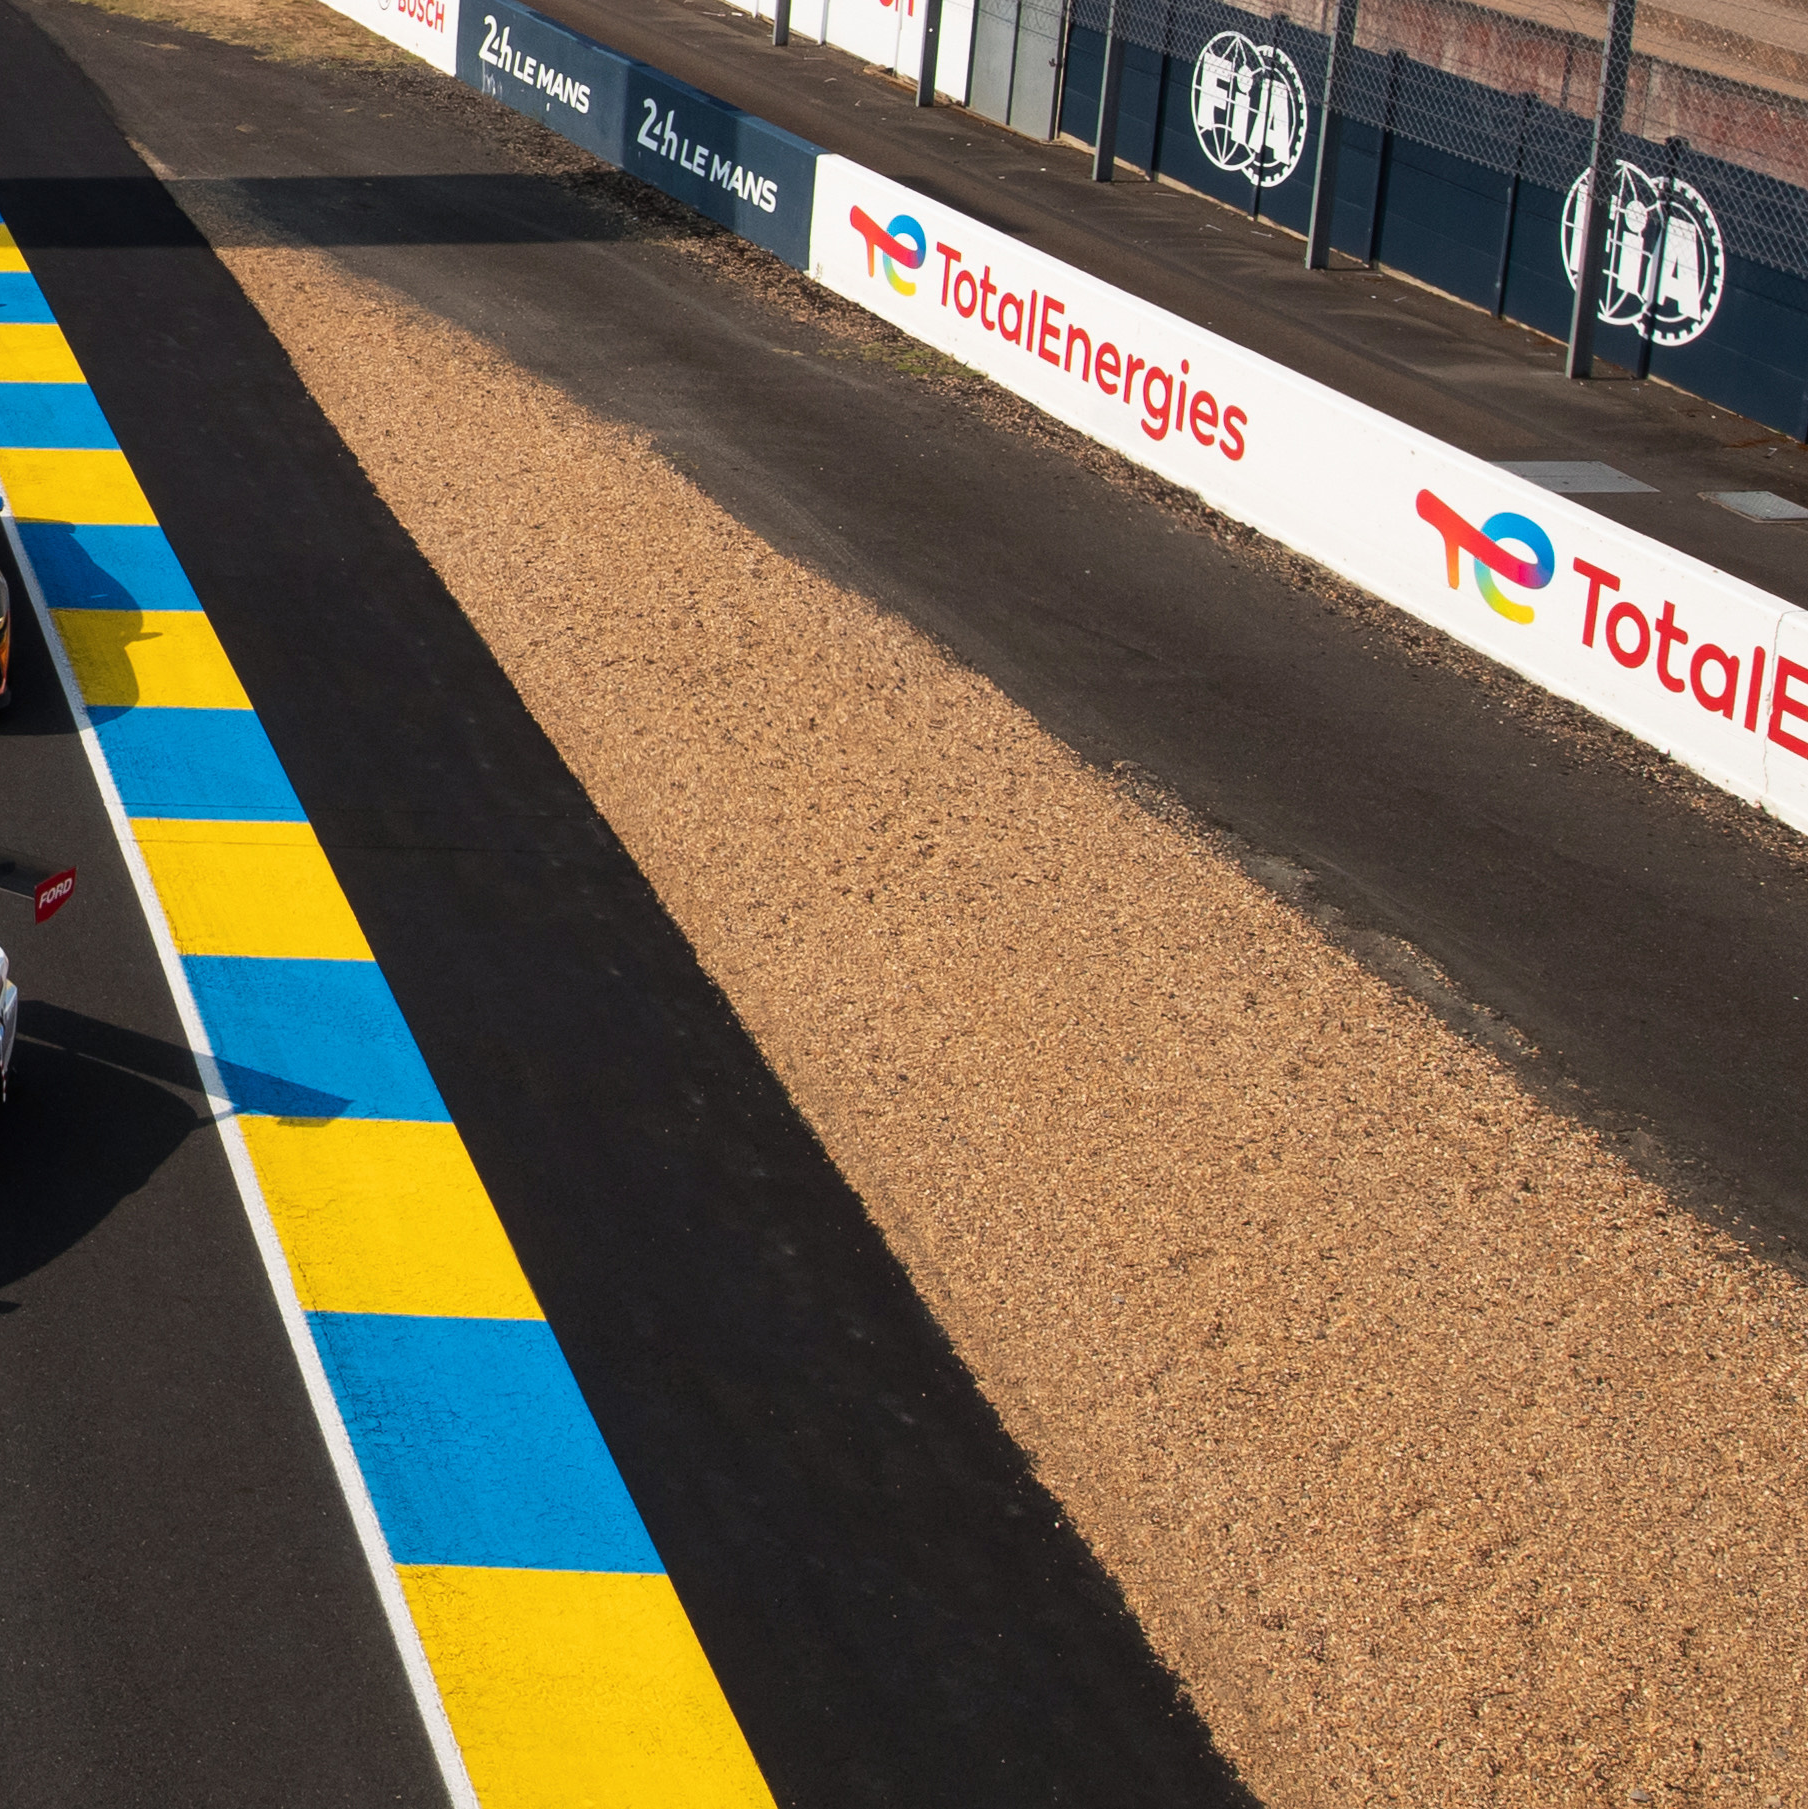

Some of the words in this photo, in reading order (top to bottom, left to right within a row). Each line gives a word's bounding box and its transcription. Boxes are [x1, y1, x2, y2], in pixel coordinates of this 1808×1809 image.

[513, 51, 535, 80] LE
[535, 67, 591, 115] MANS
[681, 138, 707, 172] LE
[709, 153, 778, 214] MANS
[934, 241, 1248, 462] TotalEnergies
[38, 877, 73, 909] FORD
